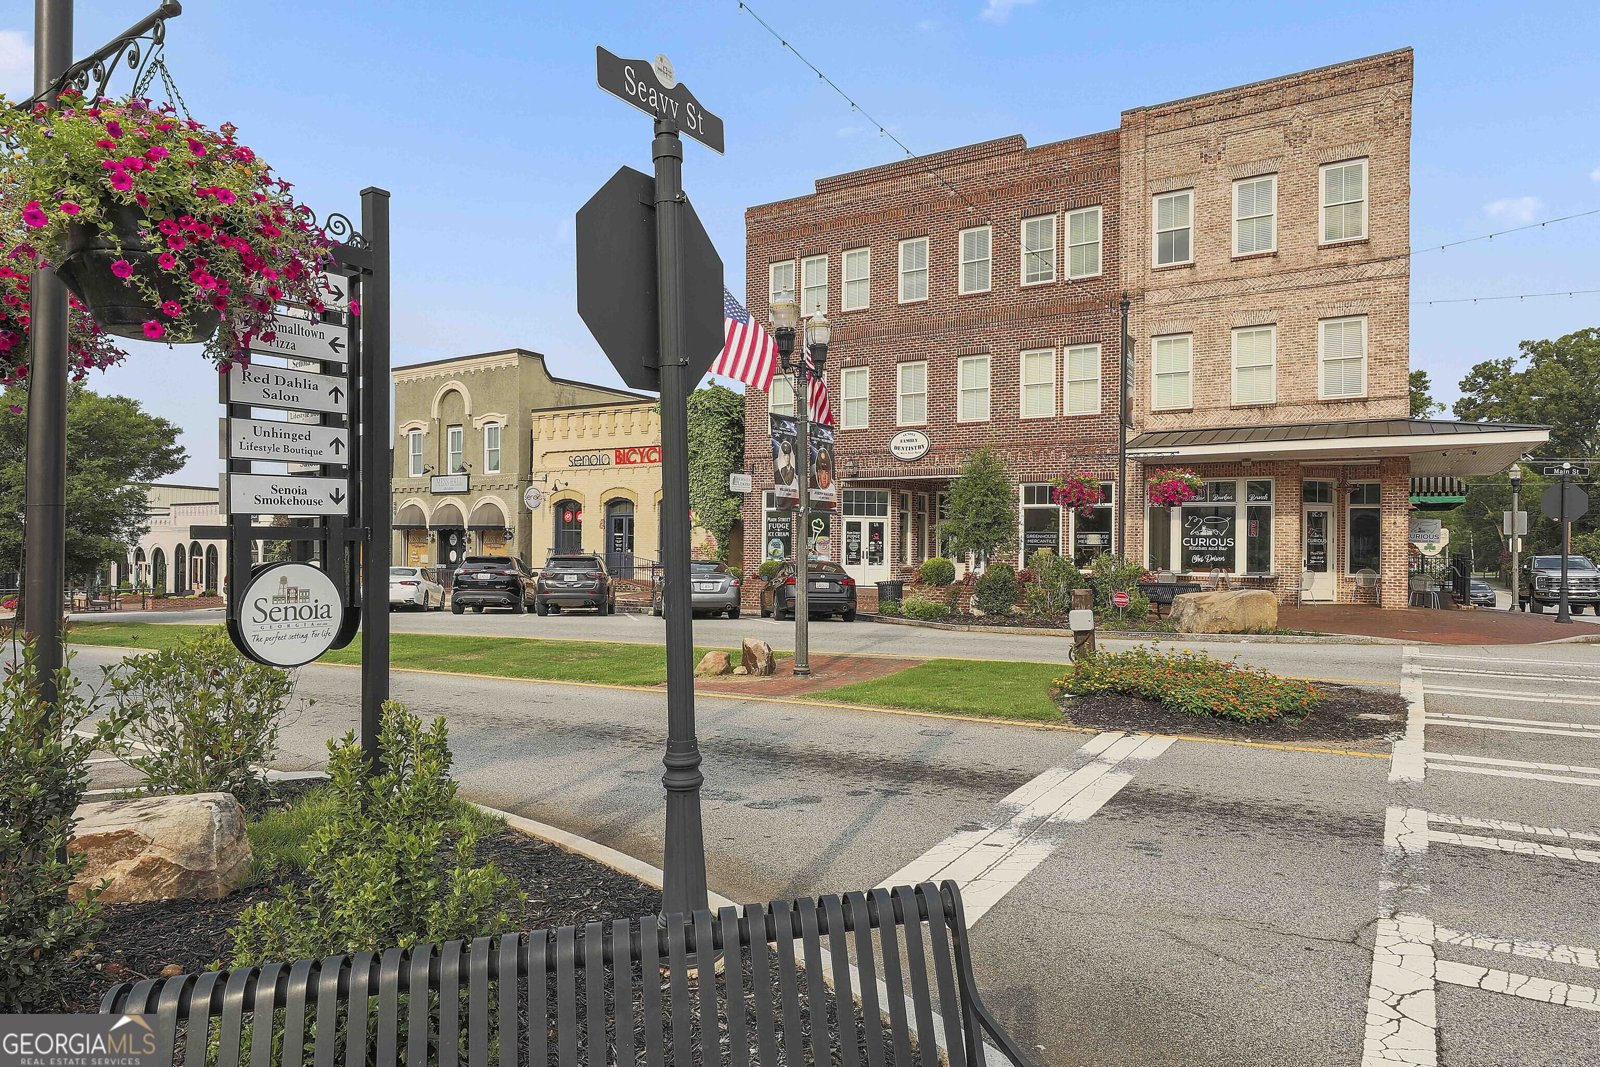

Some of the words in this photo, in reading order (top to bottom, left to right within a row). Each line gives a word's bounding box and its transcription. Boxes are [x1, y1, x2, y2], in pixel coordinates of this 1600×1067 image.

[624, 65, 679, 119] Seavy
[686, 102, 704, 135] St
[271, 322, 325, 340] Smalltown
[242, 371, 270, 385] Red
[274, 374, 319, 391] Dahlia
[262, 388, 300, 402] Salon
[253, 425, 311, 442] Unhinged
[239, 441, 280, 454] Lifestyle
[283, 444, 323, 457] Boutique
[270, 484, 308, 496] Senoia
[254, 494, 324, 506] Smokehouse
[768, 522, 790, 530] FUDGE
[1182, 537, 1235, 547] CURIOUS
[252, 597, 333, 624] Senoia
[260, 622, 315, 630] GEORGIA
[252, 634, 263, 643] The
[264, 631, 287, 645] perfect
[288, 632, 309, 643] setting
[311, 629, 320, 638] For
[321, 628, 332, 640] life
